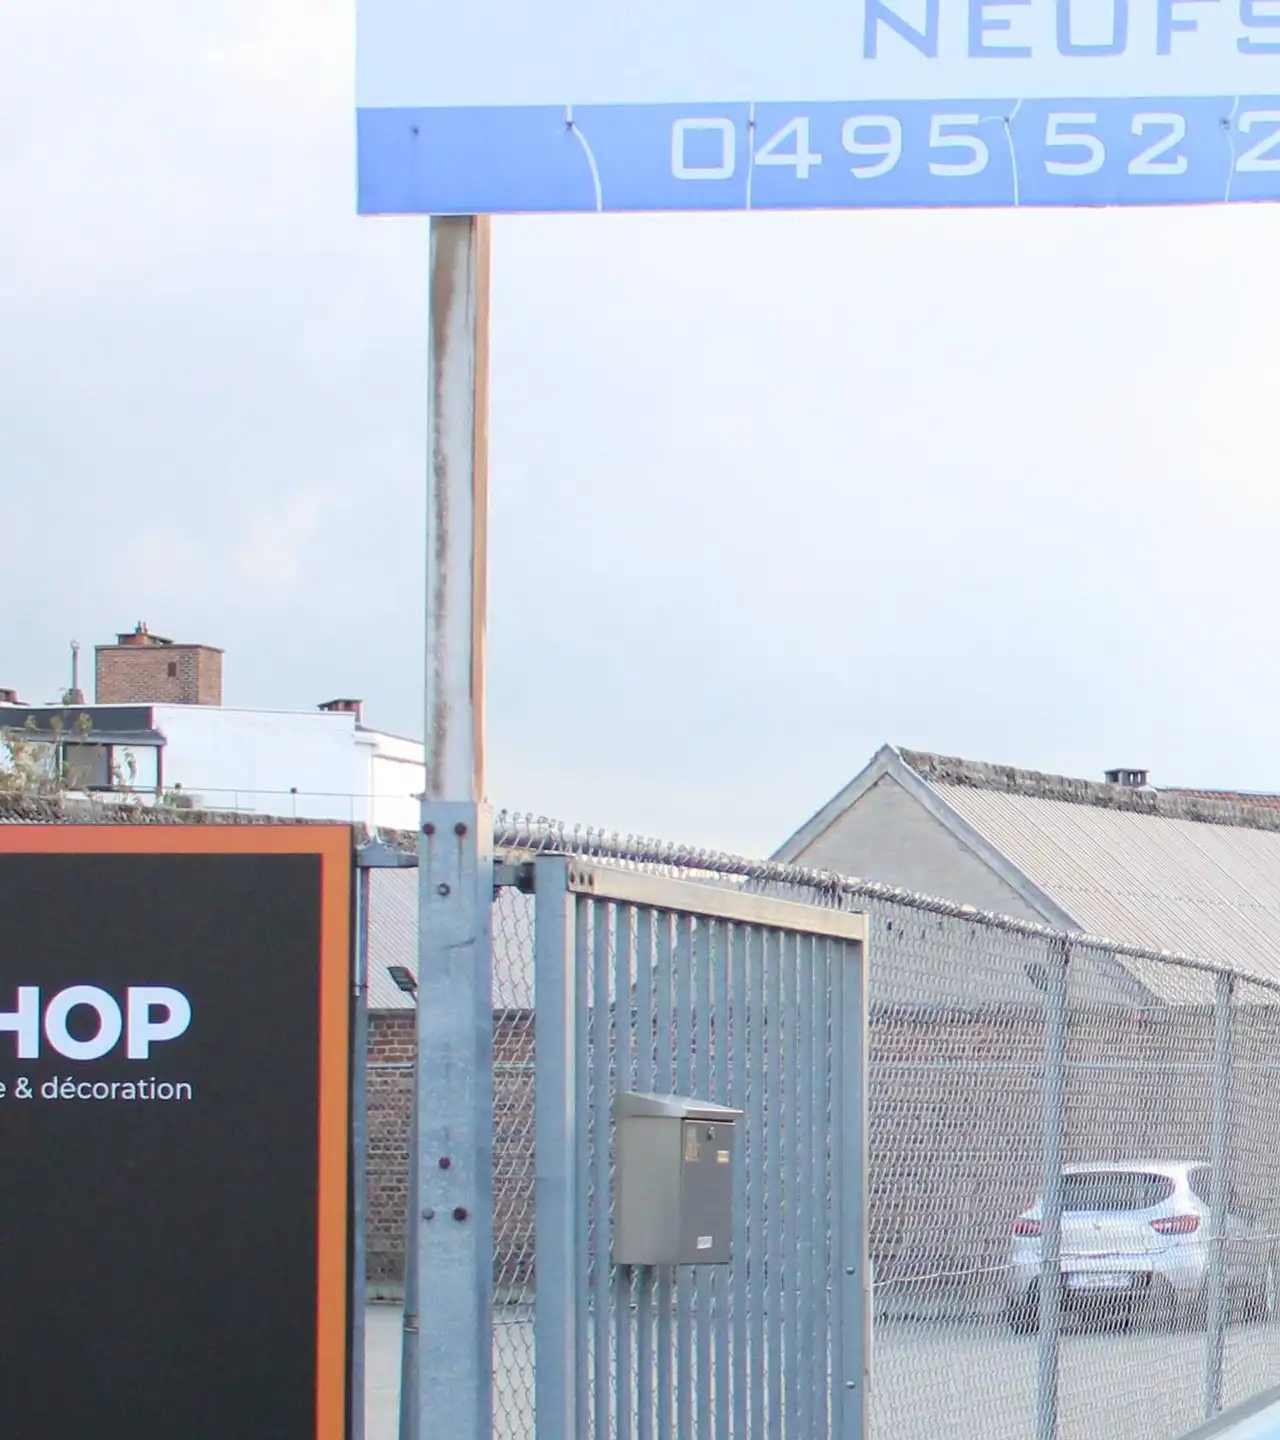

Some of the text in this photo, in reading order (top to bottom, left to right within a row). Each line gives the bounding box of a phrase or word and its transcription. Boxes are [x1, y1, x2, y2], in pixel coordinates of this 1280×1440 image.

[671, 113, 990, 179] 0495
[1044, 112, 1188, 176] 52
[14, 1077, 33, 1099] &
[41, 1075, 192, 1100] décoration
